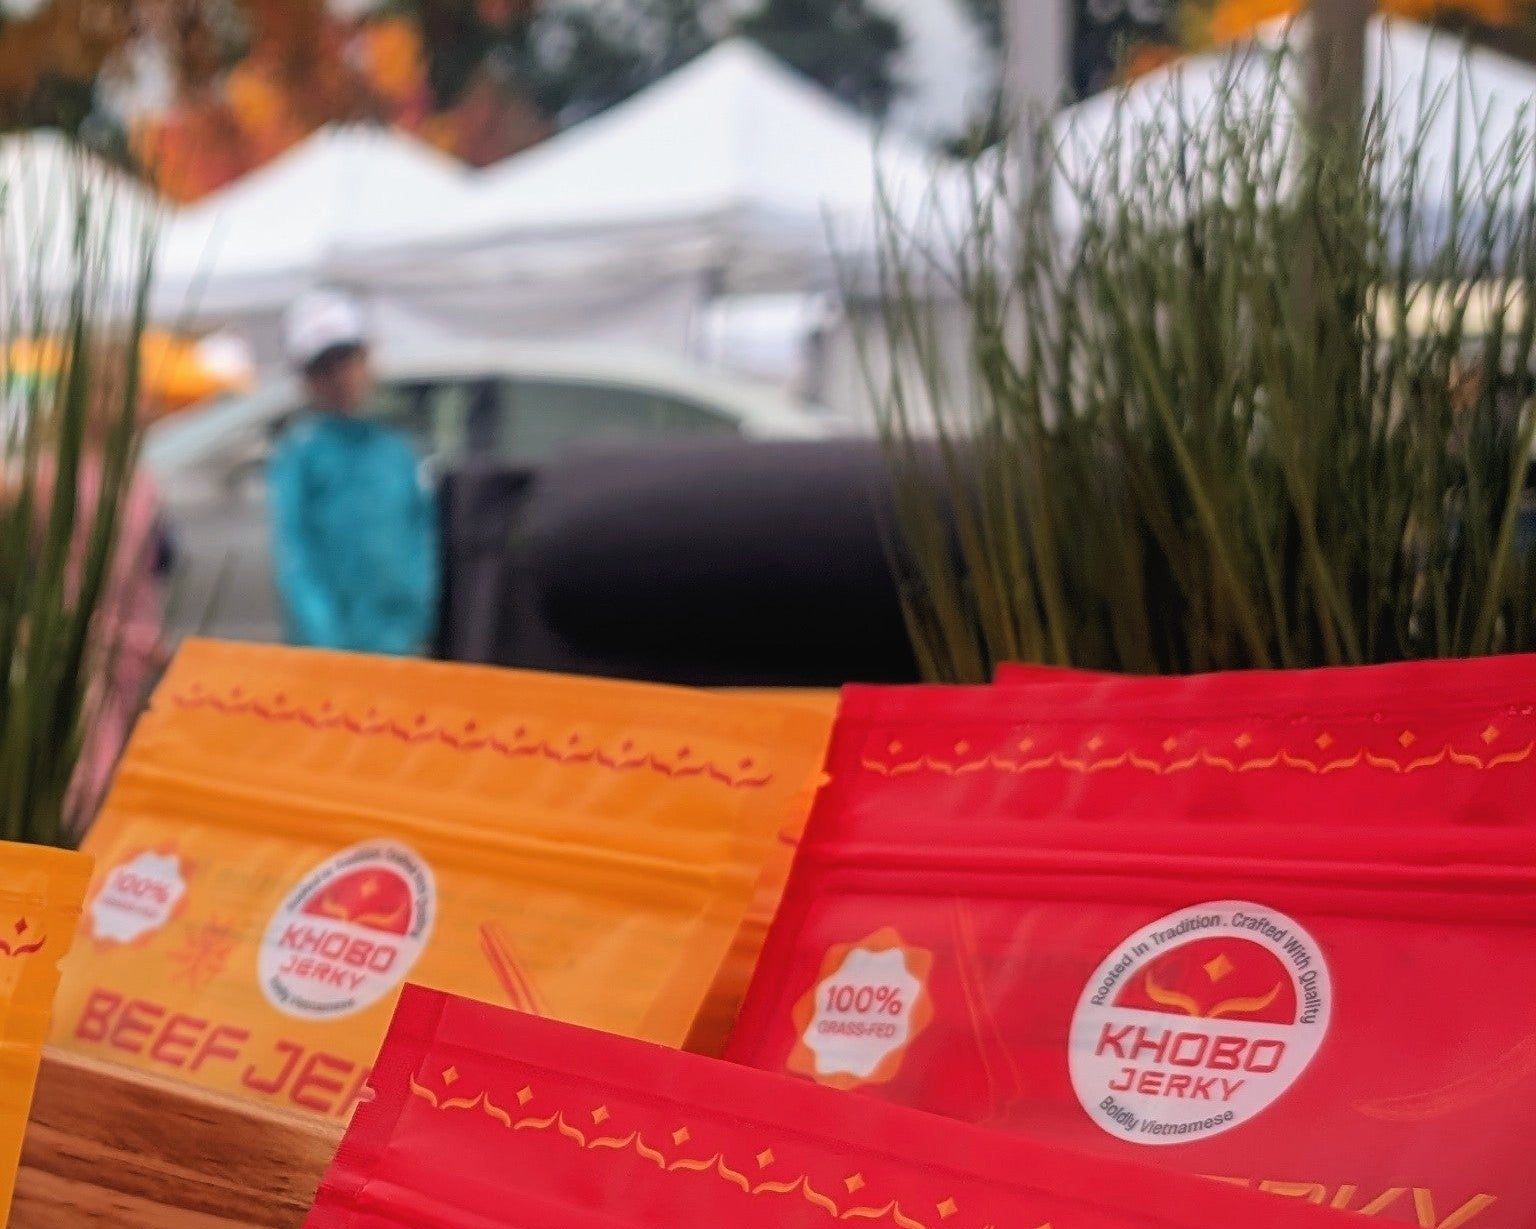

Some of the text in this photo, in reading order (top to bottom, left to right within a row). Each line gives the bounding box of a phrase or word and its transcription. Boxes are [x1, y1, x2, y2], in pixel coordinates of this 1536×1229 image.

[277, 923, 398, 975] KHOBO
[1091, 912, 1322, 1024] Rooted In Tradition Crafted With Quality
[279, 954, 365, 991] JERKY
[825, 985, 902, 1016] 100%
[75, 986, 249, 1072] BEEF
[1094, 1021, 1286, 1074] KHOBO
[1108, 1067, 1245, 1102] JERKY
[1099, 1095, 1234, 1135] Boldly Vietnamese
